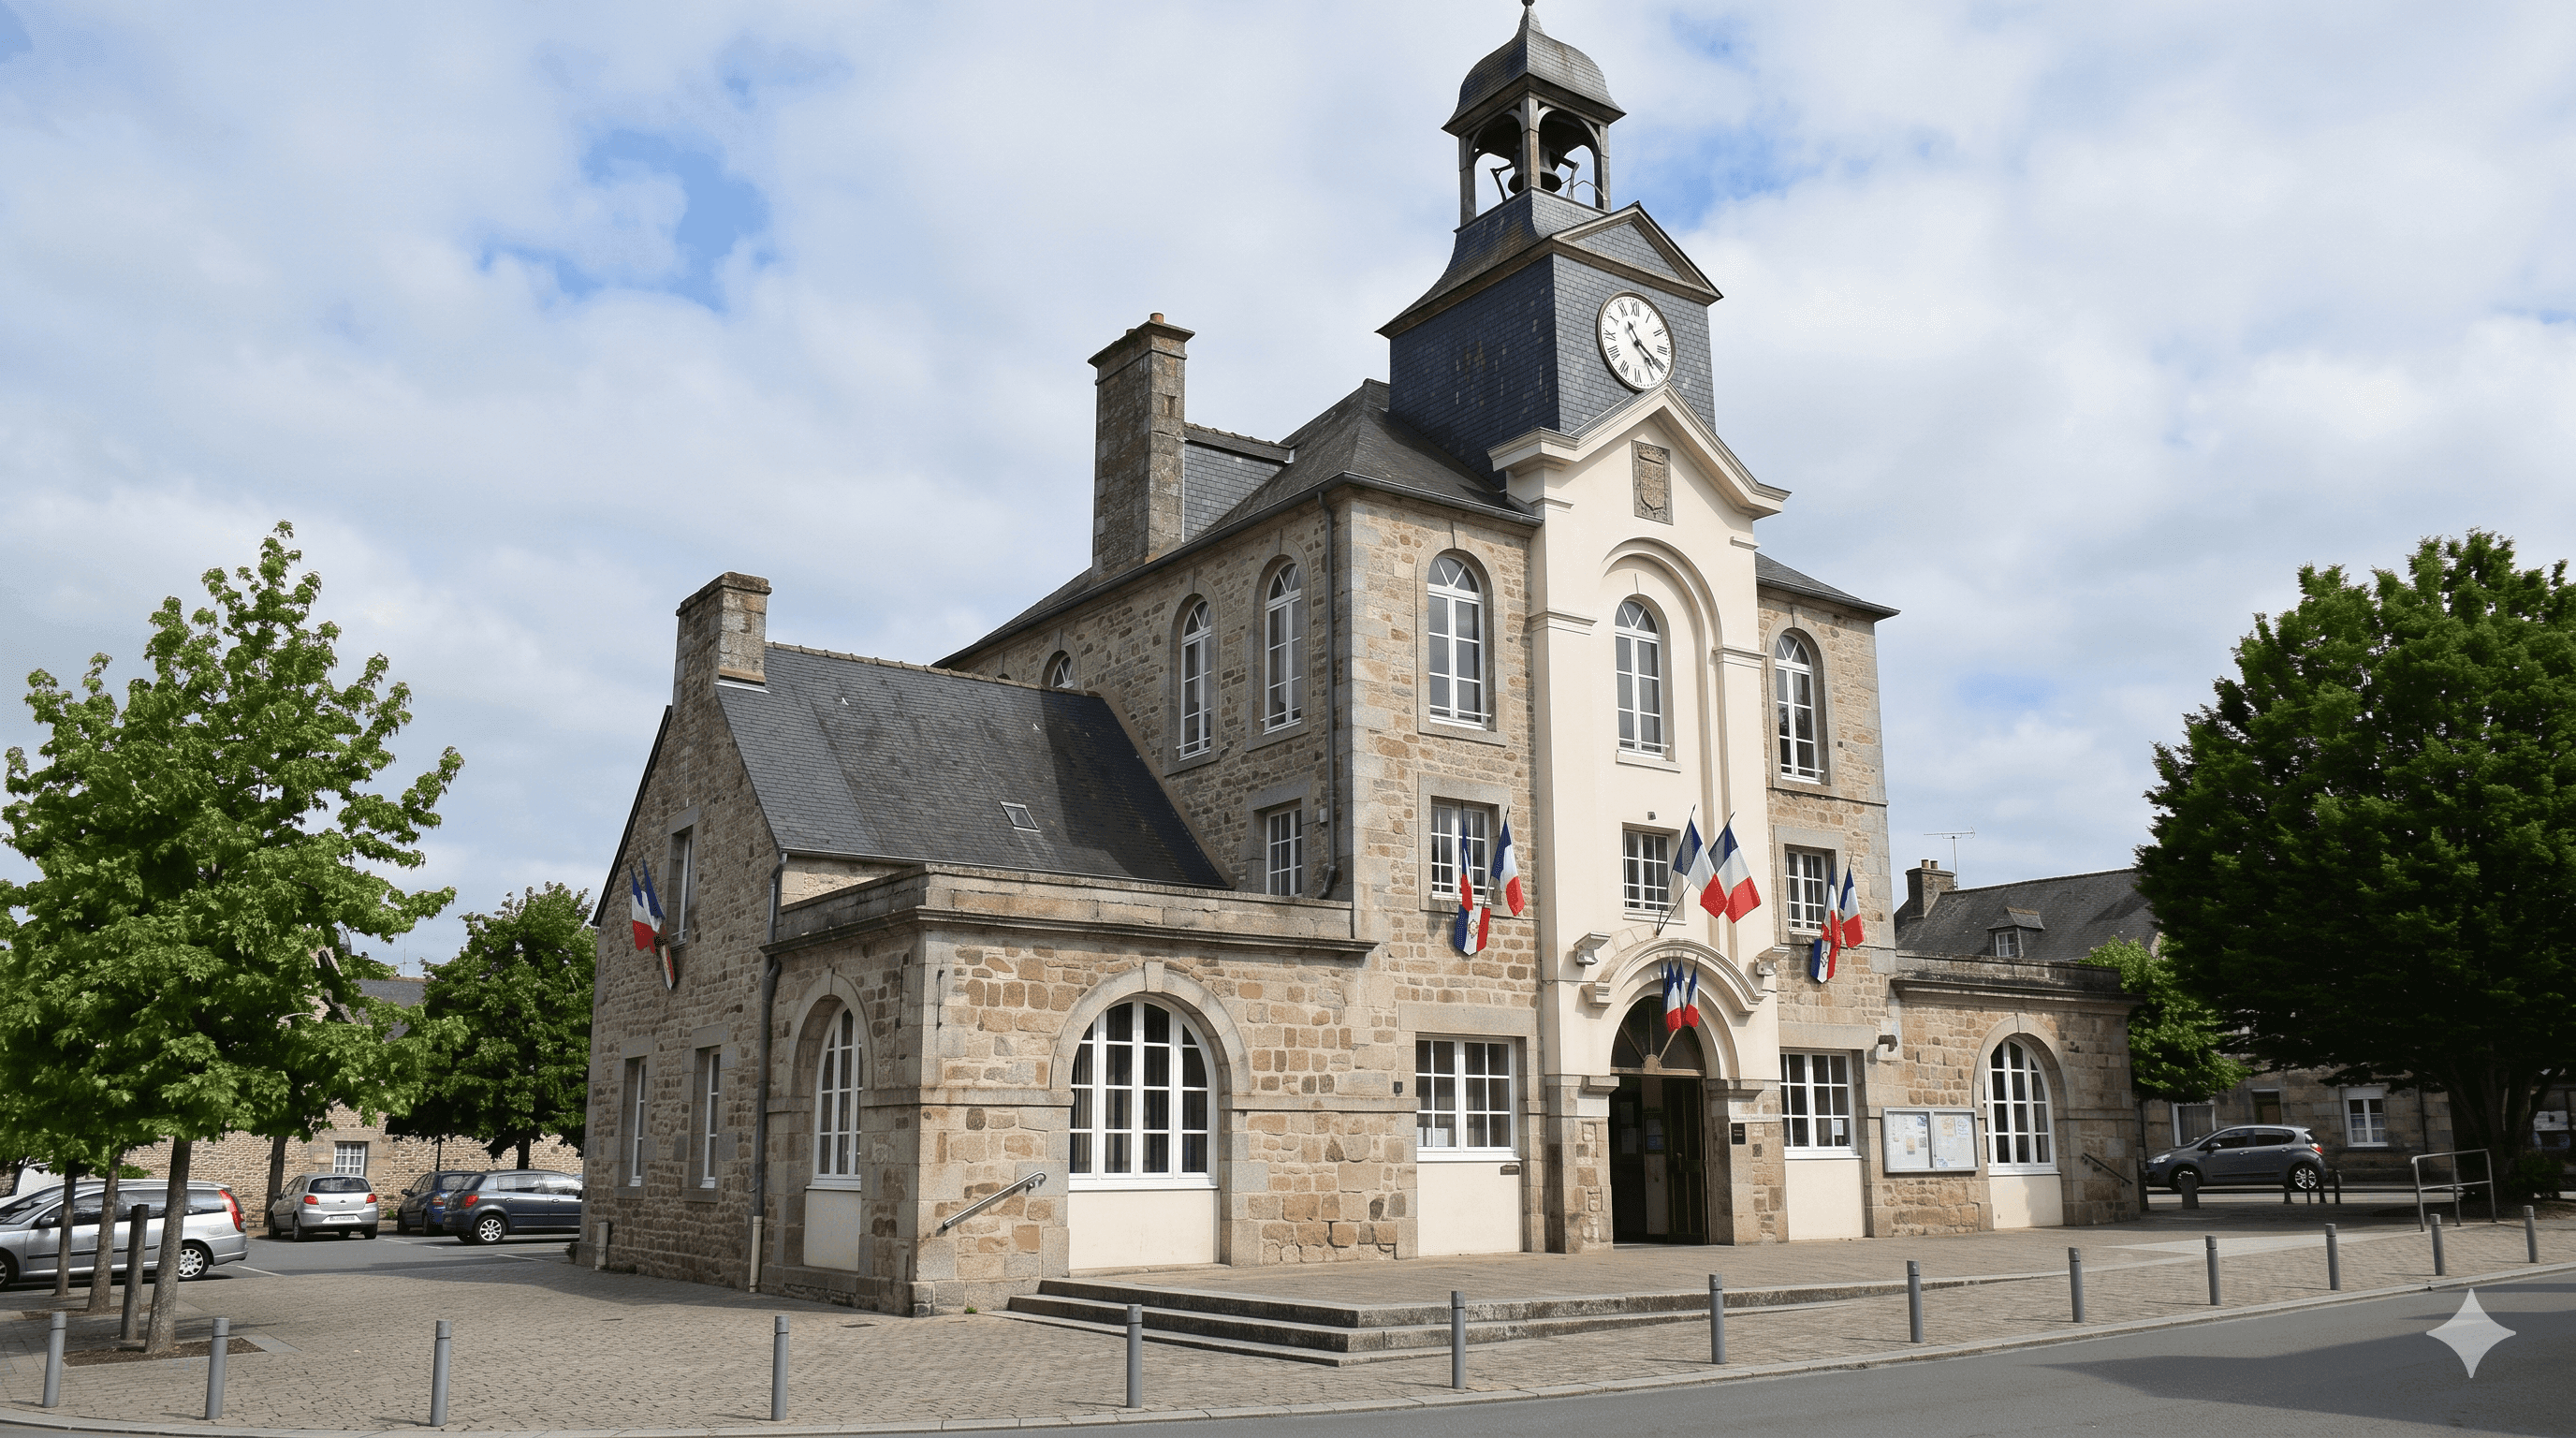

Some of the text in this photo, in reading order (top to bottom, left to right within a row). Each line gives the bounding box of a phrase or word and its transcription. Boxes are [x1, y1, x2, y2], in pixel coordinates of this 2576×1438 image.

[1630, 301, 1640, 317] XII
[1646, 311, 1652, 323] I
[1653, 329, 1665, 337] II
[1657, 345, 1668, 356] III
